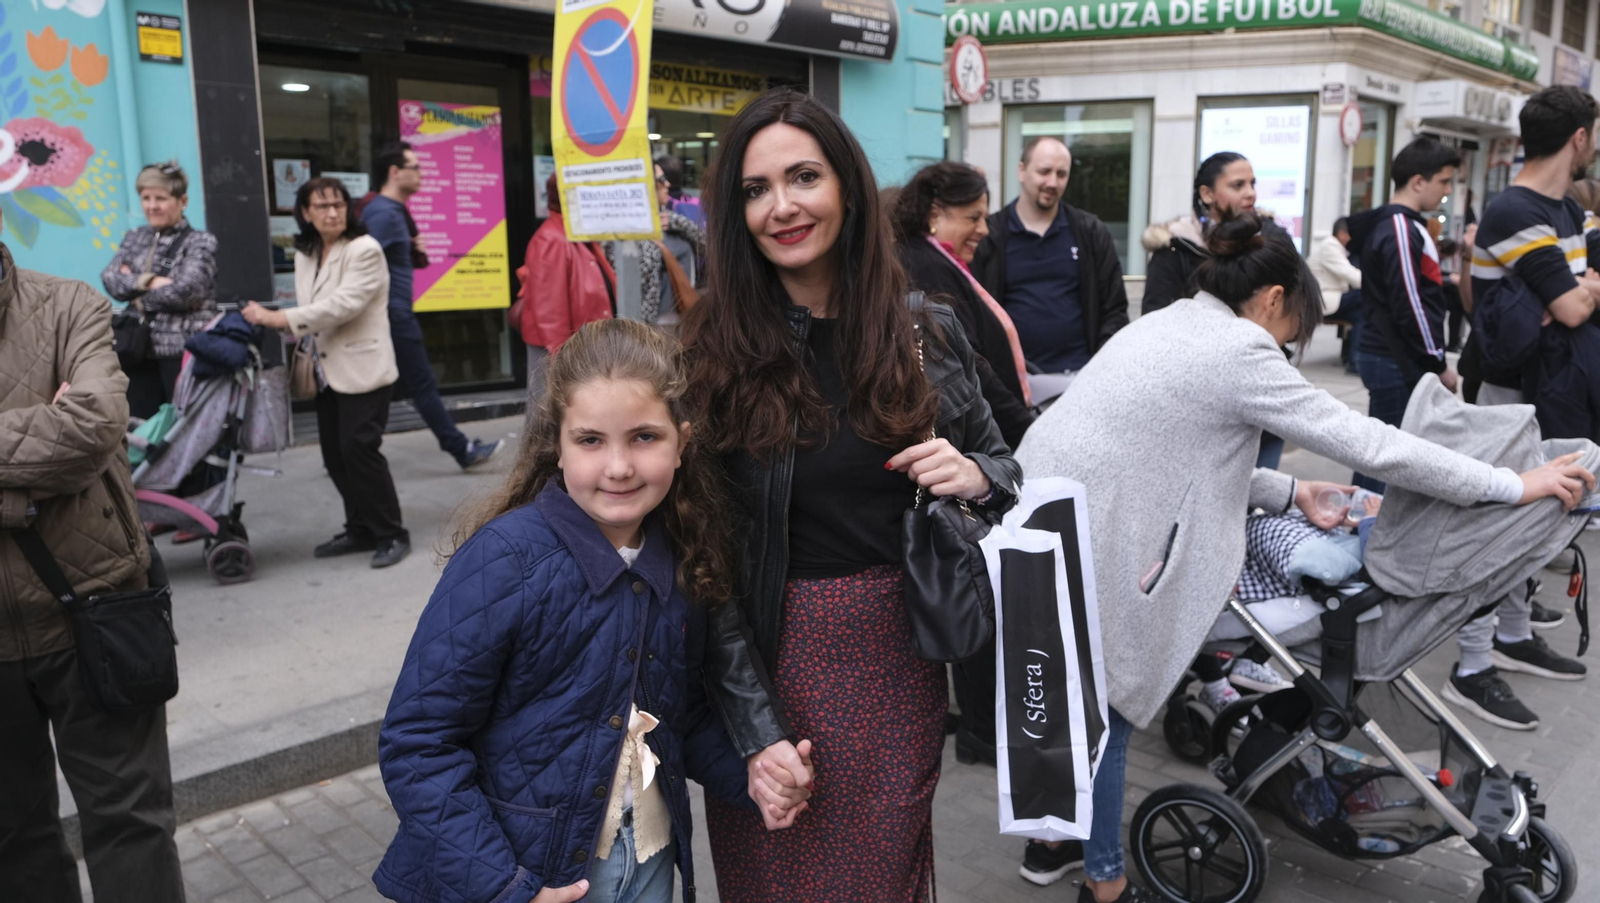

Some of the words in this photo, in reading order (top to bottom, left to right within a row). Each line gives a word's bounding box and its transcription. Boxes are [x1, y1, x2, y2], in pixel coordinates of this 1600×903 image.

[997, 2, 1162, 36] ANDALUZA
[1169, 0, 1209, 25] DE
[1217, 0, 1341, 23] FUTBOL
[668, 85, 737, 111] ARTE
[1265, 115, 1302, 128] SILLAS
[1259, 131, 1301, 145] GAMING
